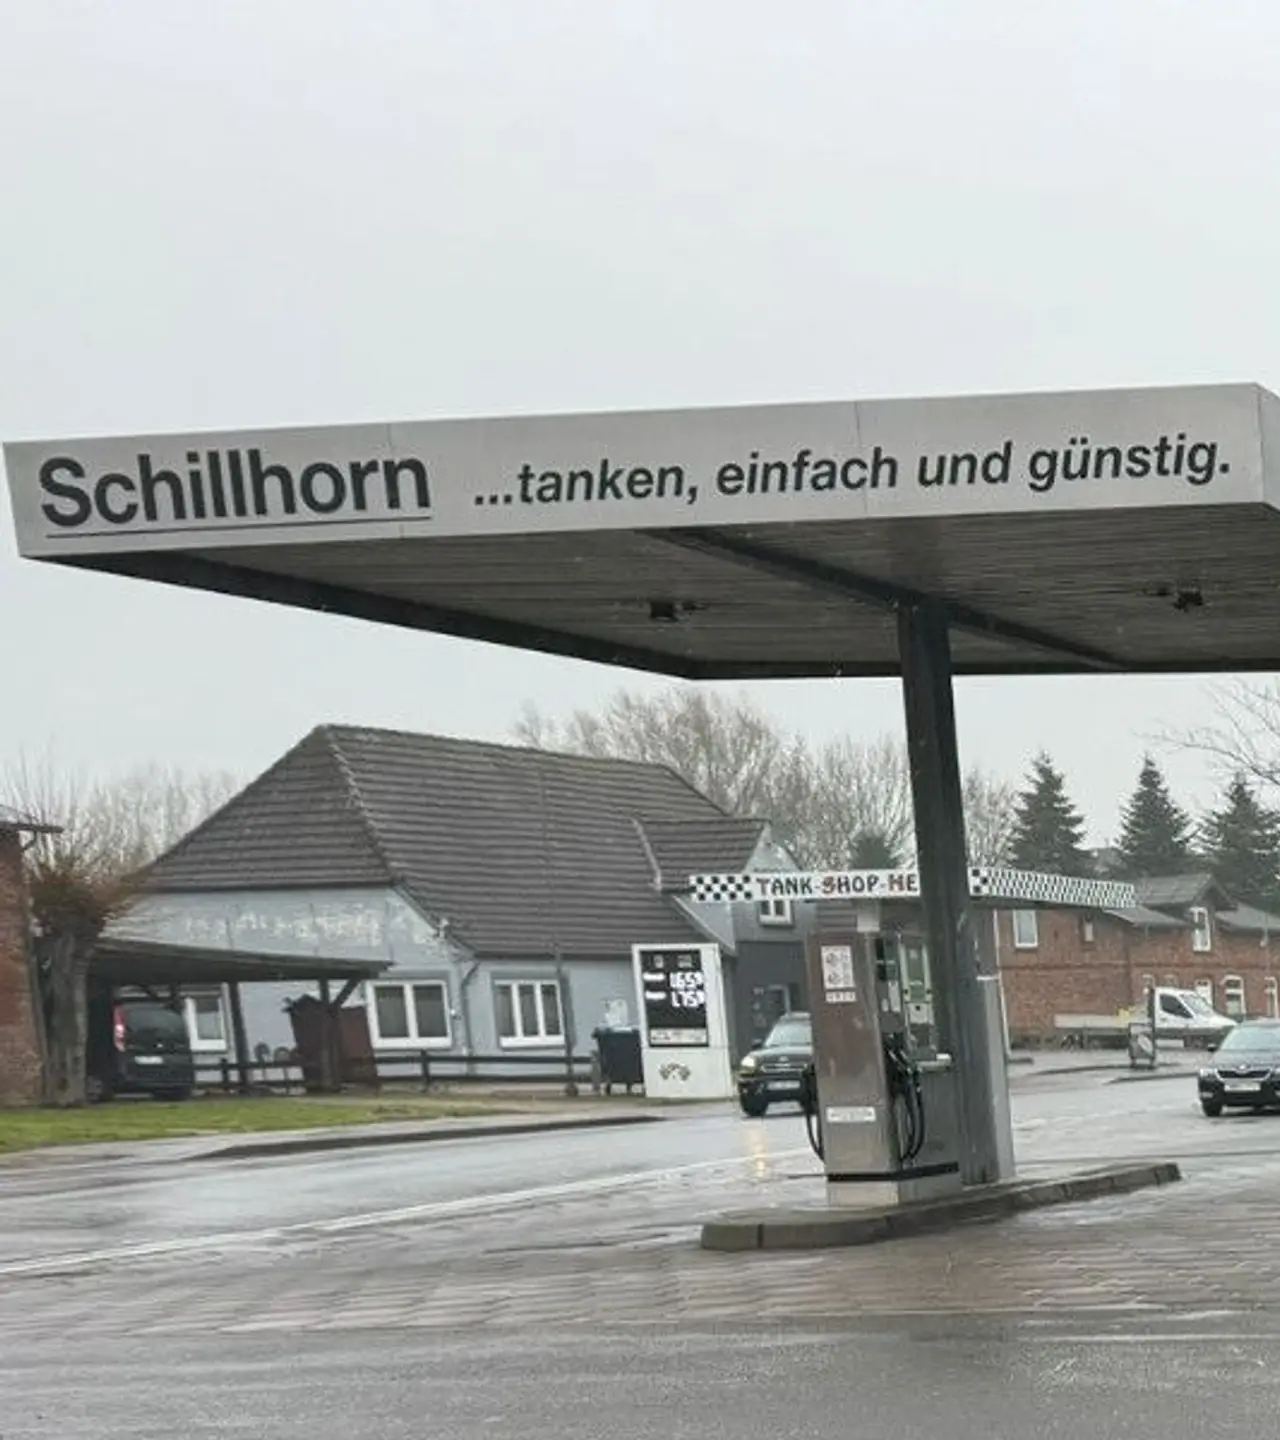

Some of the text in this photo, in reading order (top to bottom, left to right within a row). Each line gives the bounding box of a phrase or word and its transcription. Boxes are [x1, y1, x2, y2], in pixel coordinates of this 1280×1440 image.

[39, 449, 431, 526] Schillhorn
[474, 433, 1231, 507] ...tanken, einfach und günstig.
